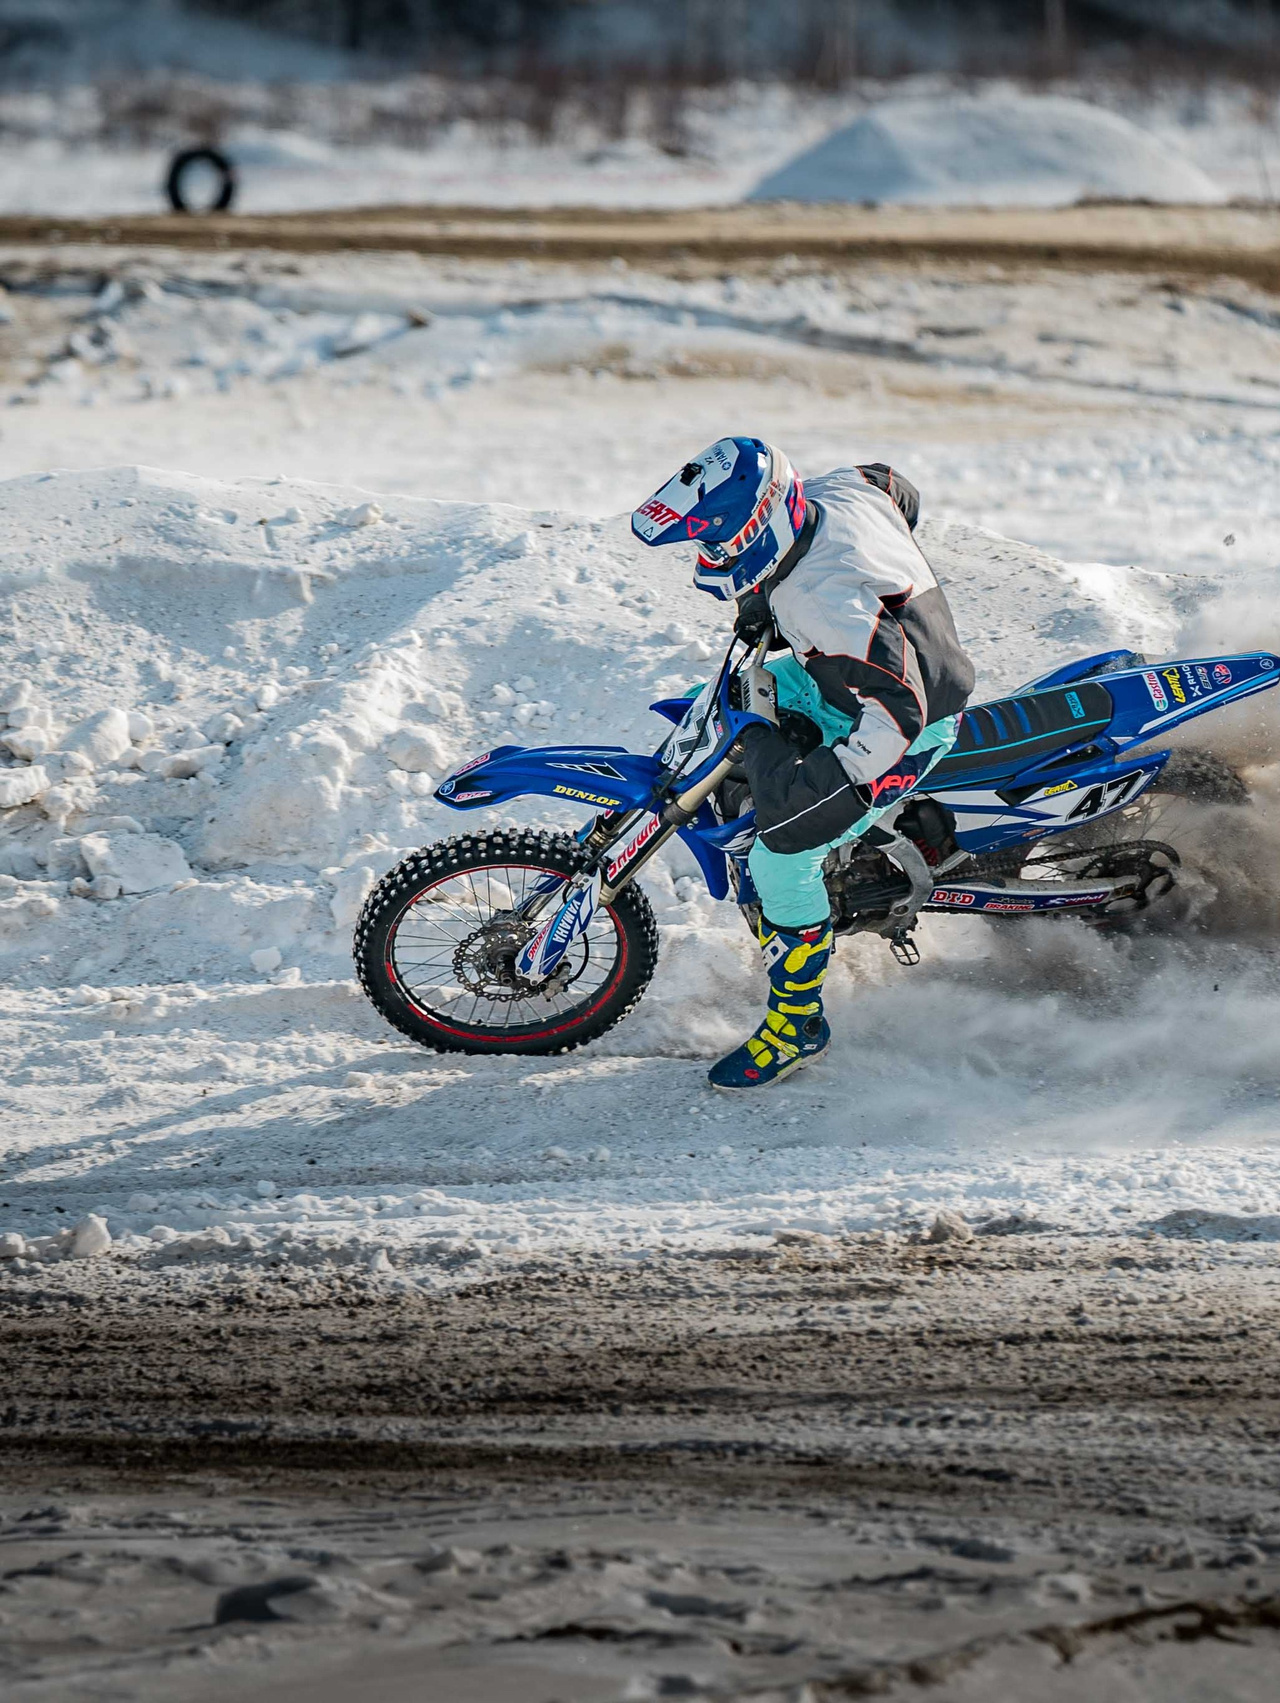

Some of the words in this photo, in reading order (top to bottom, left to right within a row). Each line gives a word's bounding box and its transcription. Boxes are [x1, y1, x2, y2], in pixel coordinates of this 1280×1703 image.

[1145, 672, 1164, 699] Castrol
[553, 784, 621, 806] DUNLOP
[1065, 769, 1144, 822] 47
[607, 814, 660, 881] SHOWA
[552, 898, 582, 943] YAMAHA
